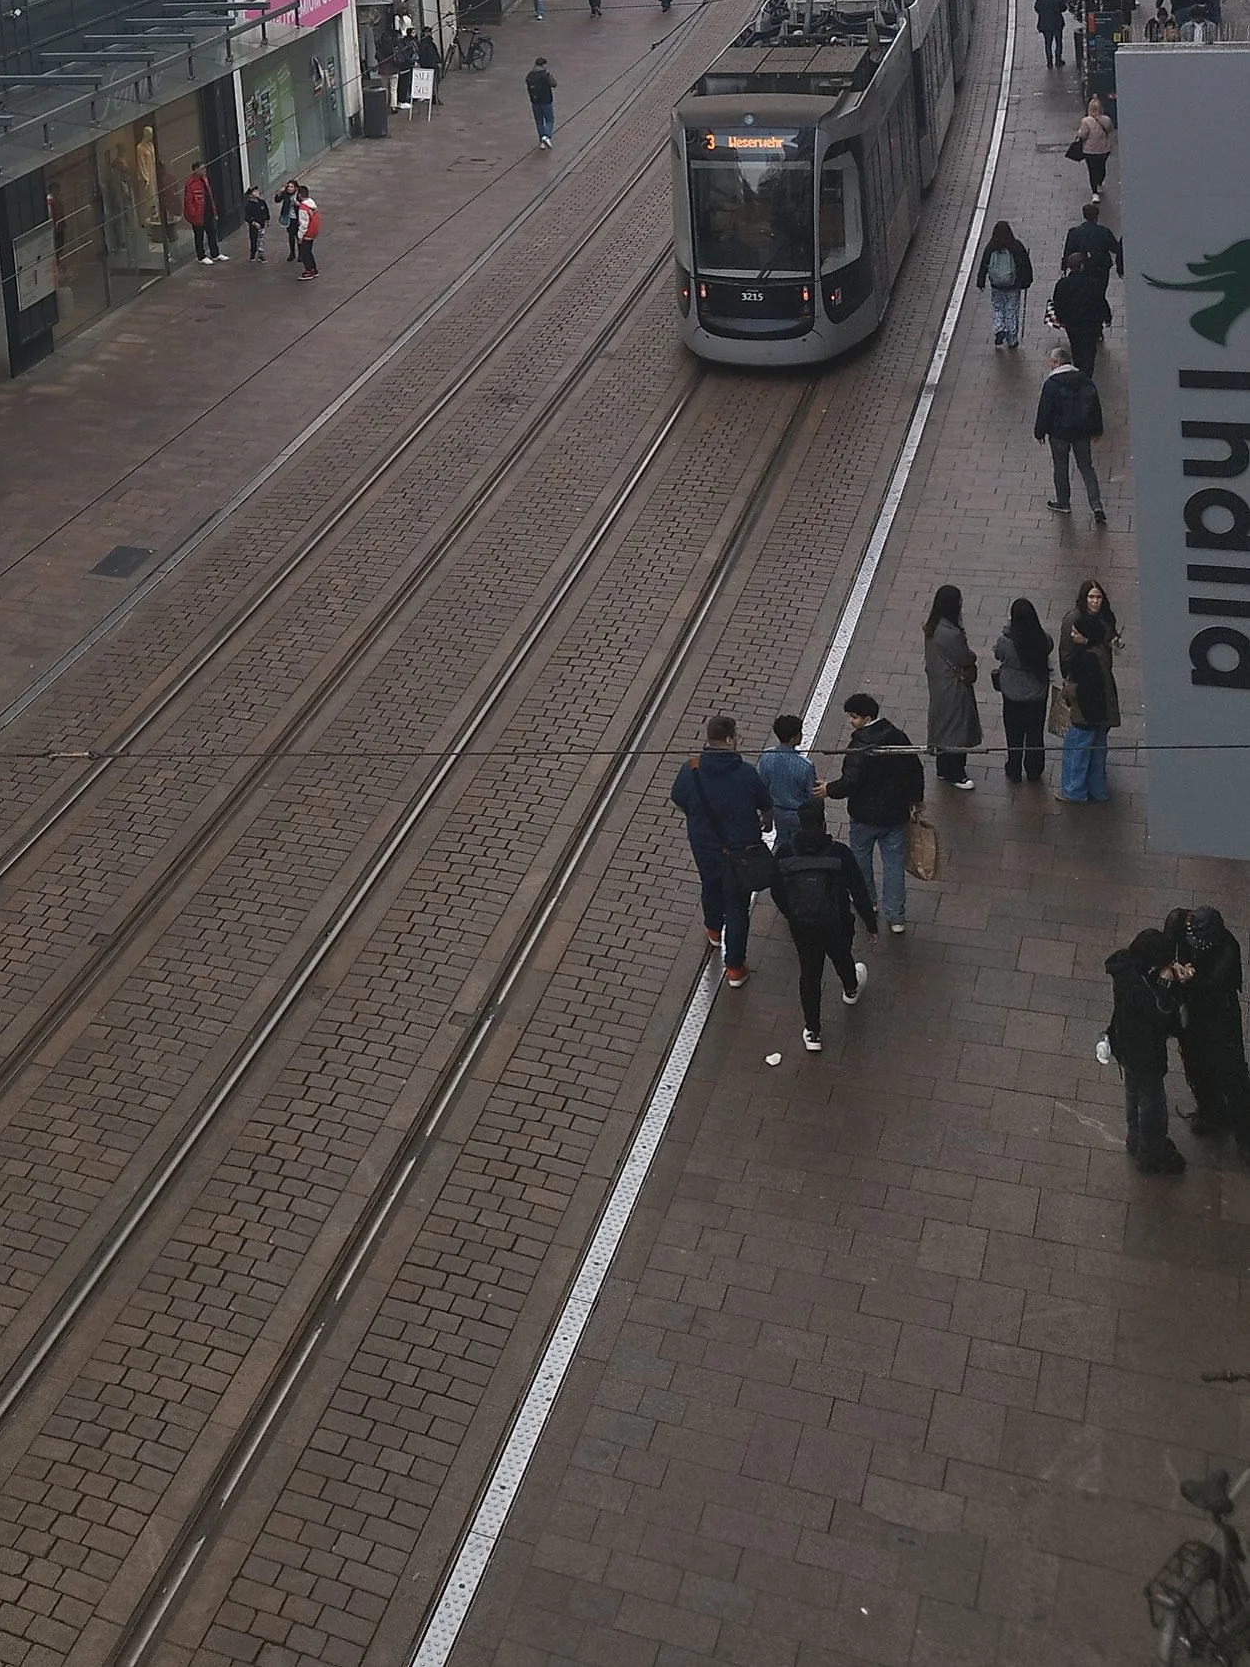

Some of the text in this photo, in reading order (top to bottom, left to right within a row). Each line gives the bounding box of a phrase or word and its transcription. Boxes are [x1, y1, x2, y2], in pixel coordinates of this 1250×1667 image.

[706, 134, 784, 150] 3 Weserwehr
[741, 292, 764, 301] 3215
